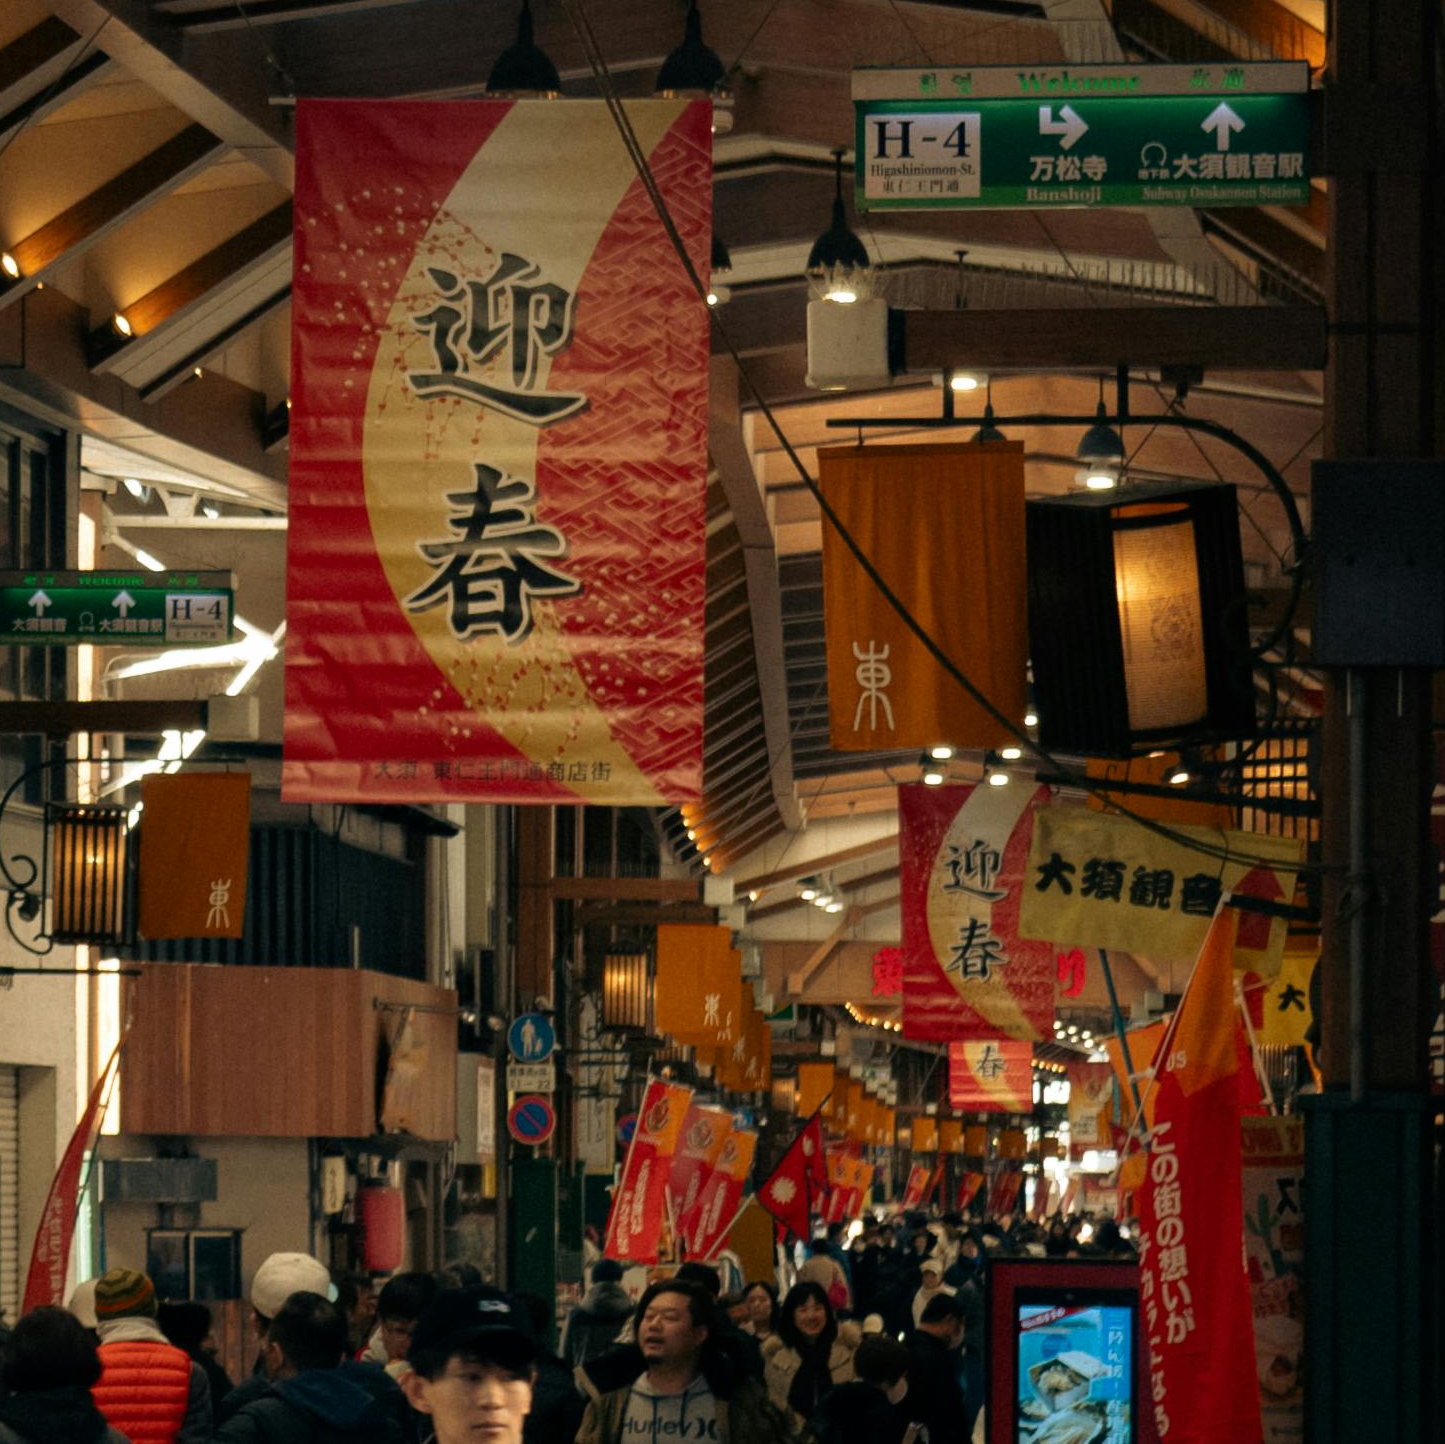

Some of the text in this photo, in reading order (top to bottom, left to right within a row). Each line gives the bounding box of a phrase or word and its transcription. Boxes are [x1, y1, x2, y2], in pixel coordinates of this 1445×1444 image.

[1017, 72, 1142, 93] Welcome
[873, 120, 972, 159] H-4
[870, 164, 975, 178] Higashiniomon-St.
[1029, 154, 1108, 182] 万松寺
[1172, 152, 1304, 180] 大須観音駅
[1026, 186, 1102, 203] Banshoji
[1142, 186, 1187, 201] Subway
[1259, 184, 1302, 199] Station
[406, 250, 587, 645] 迎春
[171, 598, 223, 621] H-4
[1035, 853, 1222, 917] 大須観音
[941, 839, 1009, 983] 迎春
[1147, 1120, 1196, 1345] この街の想いが
